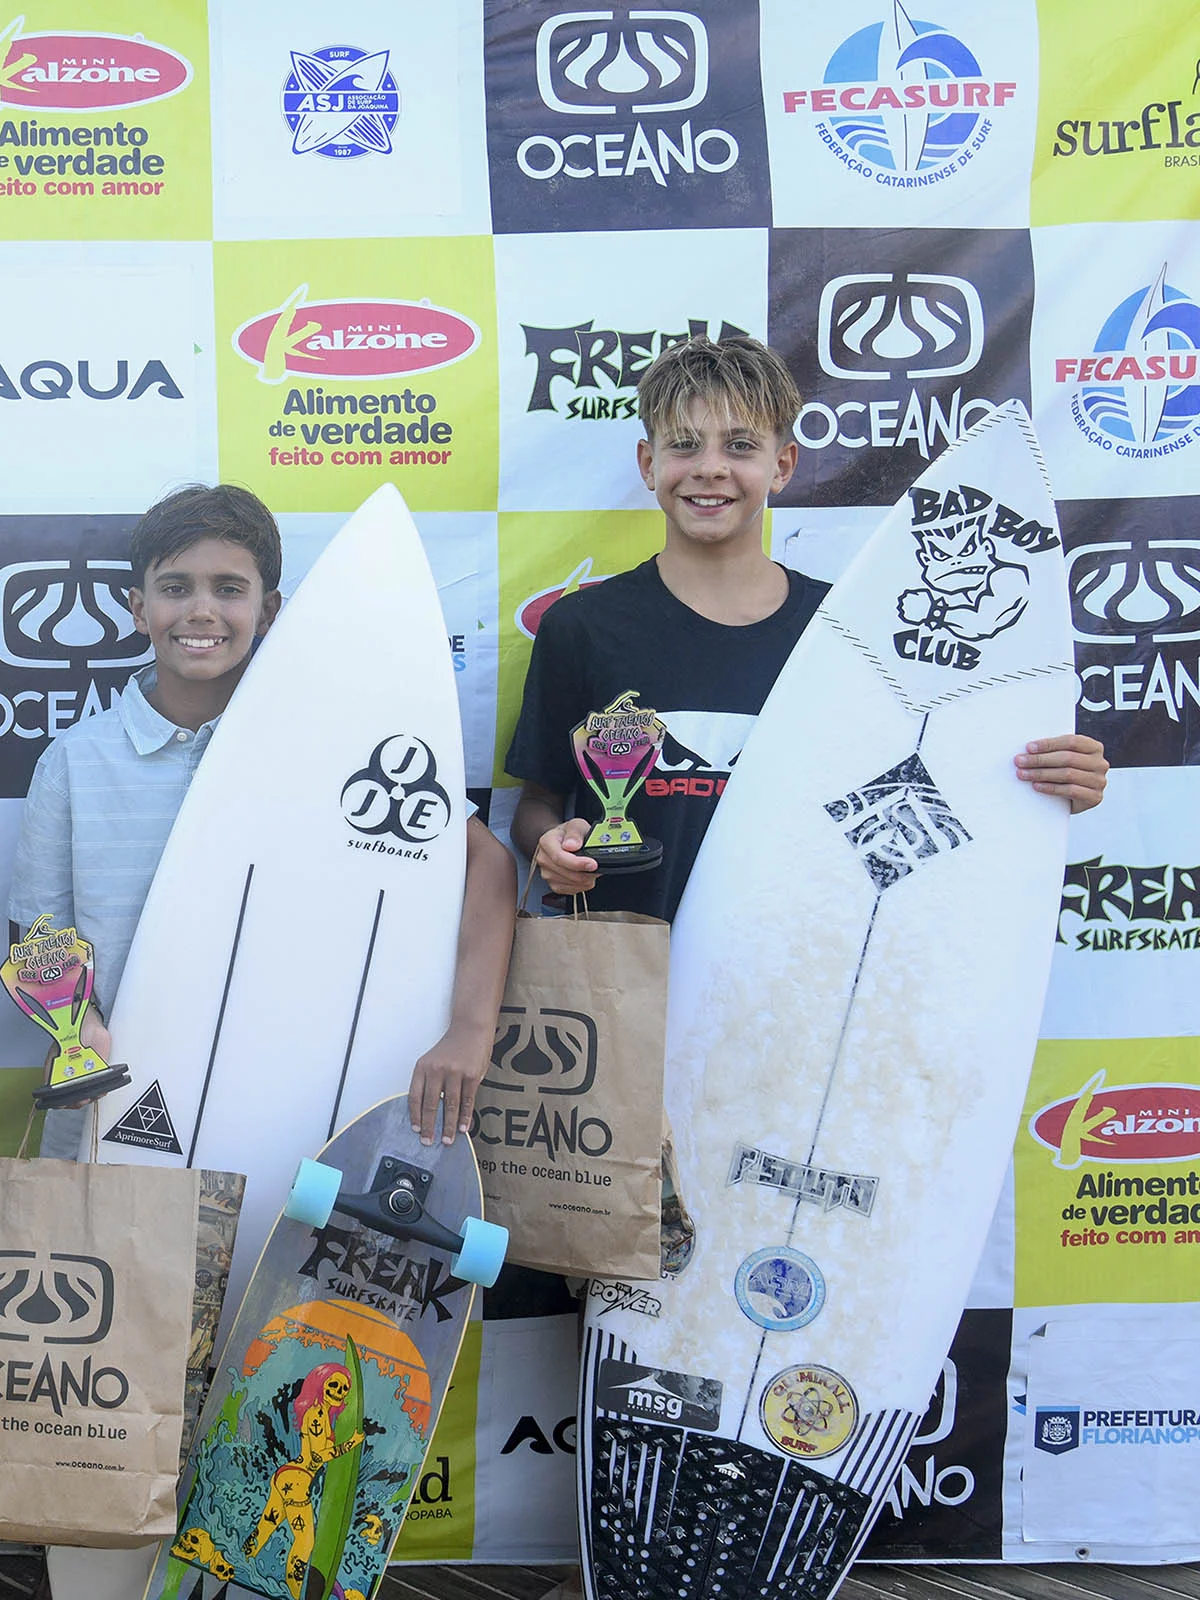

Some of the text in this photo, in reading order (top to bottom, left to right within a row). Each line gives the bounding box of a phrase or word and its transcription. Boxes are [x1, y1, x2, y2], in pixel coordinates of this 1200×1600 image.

[62, 58, 116, 66] MINI
[296, 94, 344, 112] ASJ
[783, 82, 1017, 113] FECASURF
[14, 148, 165, 177] verdade
[334, 149, 352, 157] 1987
[516, 121, 740, 187] OCEANO
[815, 117, 994, 189] FEDERAÇÃO CATARINENSE DE SURF
[43, 180, 95, 196] com
[101, 180, 164, 196] amor
[262, 288, 448, 380] Kalzone
[283, 389, 437, 416] Alimento
[268, 418, 453, 445] de verdade
[1071, 393, 1194, 459] FEDERAÇÃO CATARINENSE
[269, 447, 451, 466] feito com amor
[909, 485, 1061, 553] BAD BOY
[892, 629, 982, 671] CLUB
[1139, 1109, 1190, 1117] MINI
[115, 1131, 173, 1149] AprimoreSurf
[501, 1160, 612, 1187] the ocean blue
[1076, 1173, 1200, 1200] Aliment
[1062, 1205, 1086, 1220] de
[1060, 1230, 1166, 1248] feito com
[297, 1226, 466, 1323] FREAK
[325, 1275, 418, 1321] SURFSKATE
[628, 1390, 683, 1420] msg
[1, 1416, 29, 1433] the
[33, 1420, 83, 1437] ocean
[87, 1424, 128, 1441] blue
[1083, 1426, 1200, 1445] FLORIANÓP
